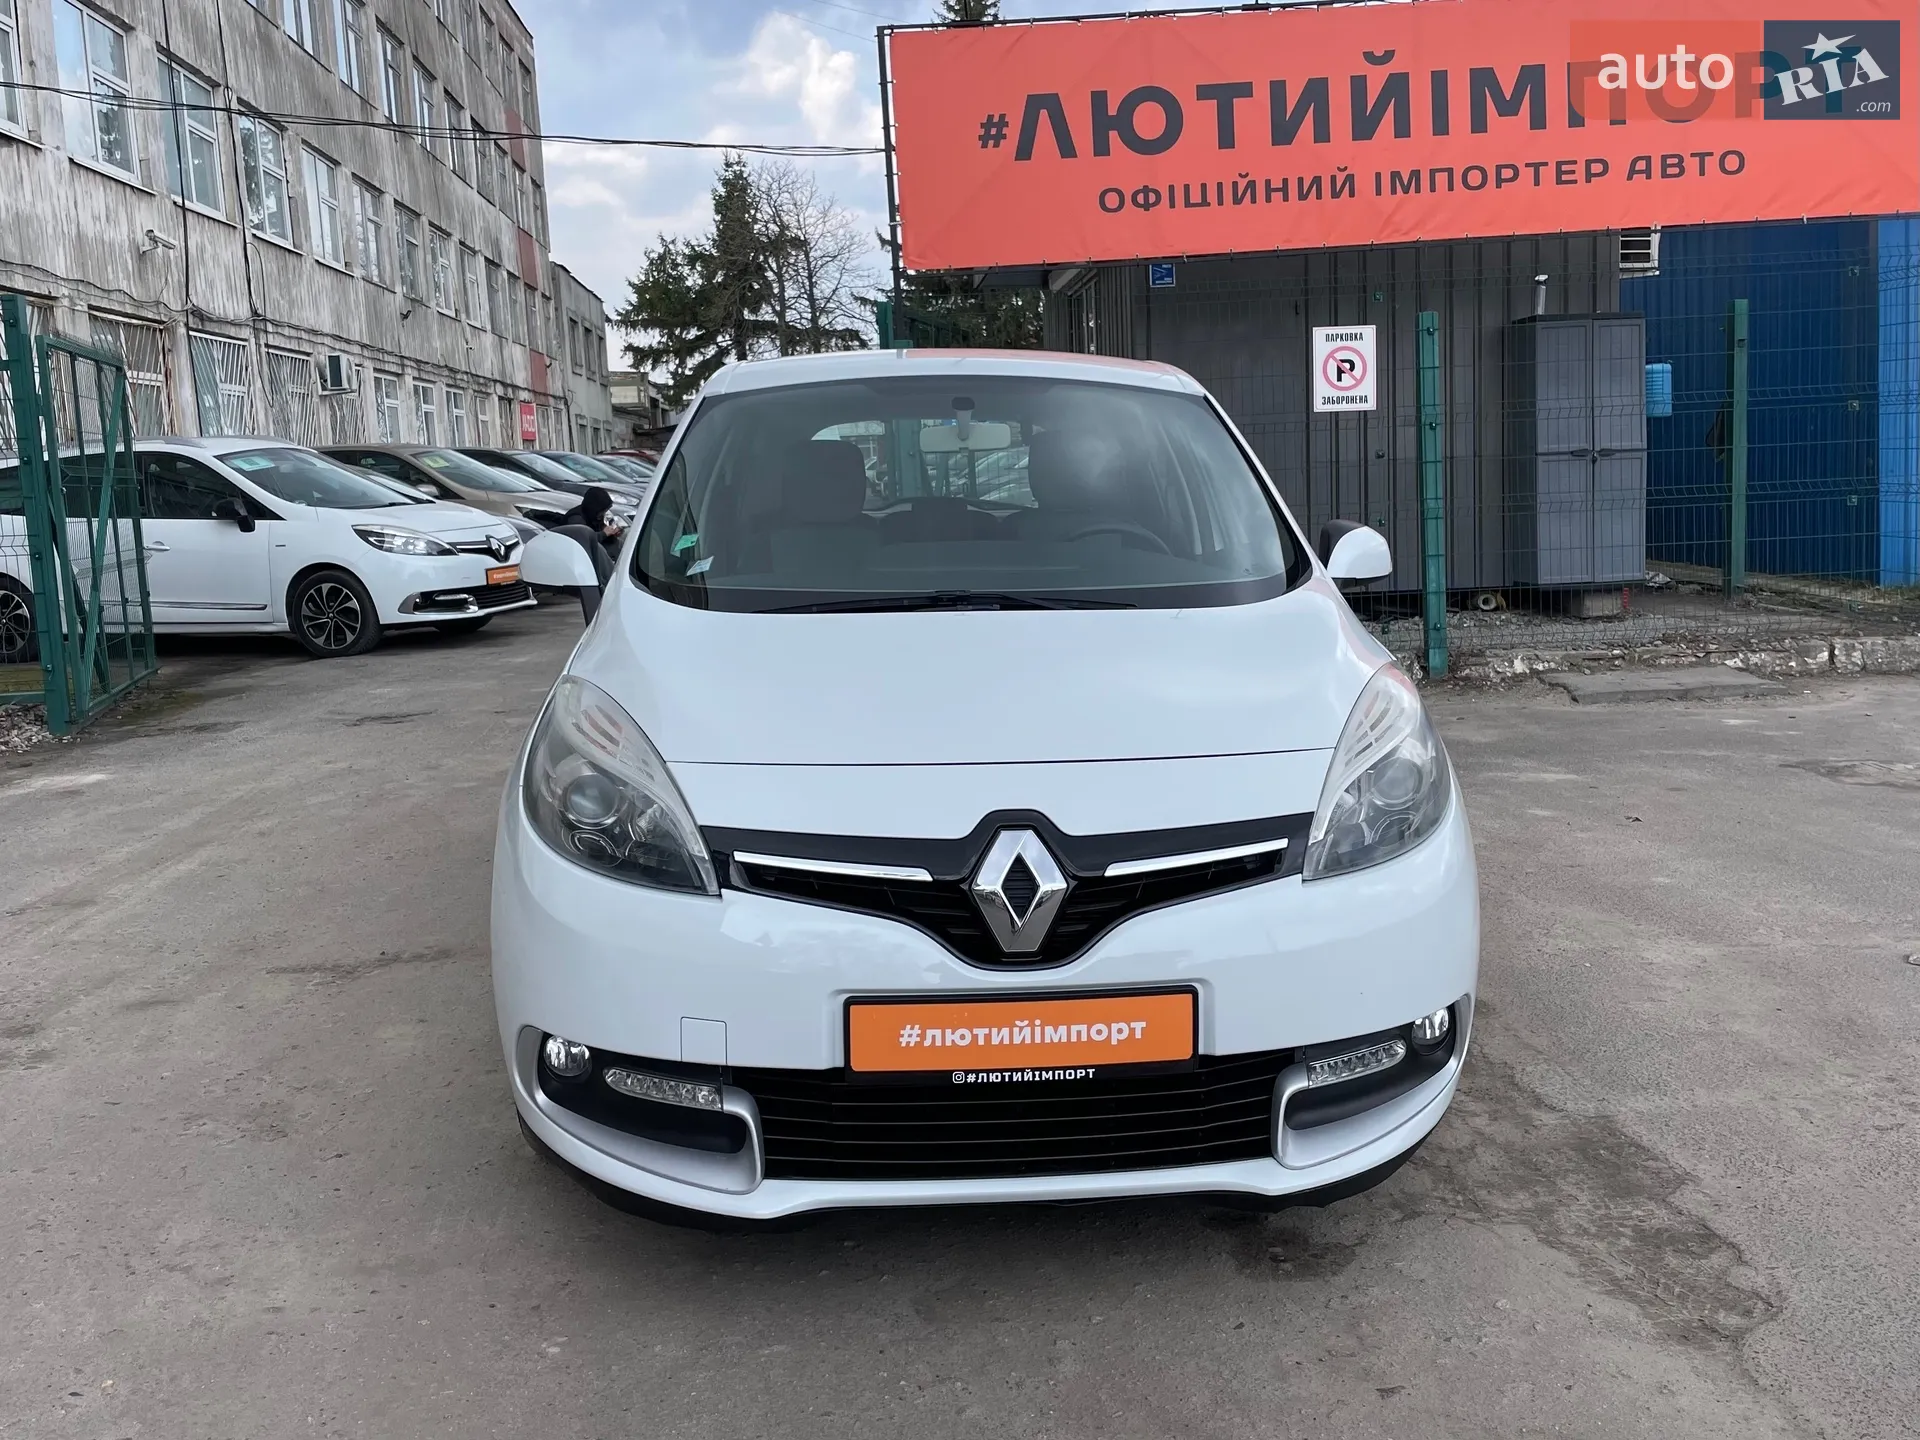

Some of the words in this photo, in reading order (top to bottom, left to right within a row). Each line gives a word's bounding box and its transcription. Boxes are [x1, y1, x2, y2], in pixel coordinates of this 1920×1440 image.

[1098, 165, 1356, 213] ОФІЦІЙНИЙ
[1374, 157, 1610, 197] ІМПОРТЕР
[1625, 149, 1747, 182] АВТО
[1325, 332, 1364, 343] ПАРКОВКА
[1321, 394, 1369, 406] ЗАБОРОНЕНА
[898, 1019, 1147, 1048] #лютийімпорт
[966, 1068, 1096, 1084] #ЛЮТИЙІМПОРТ
